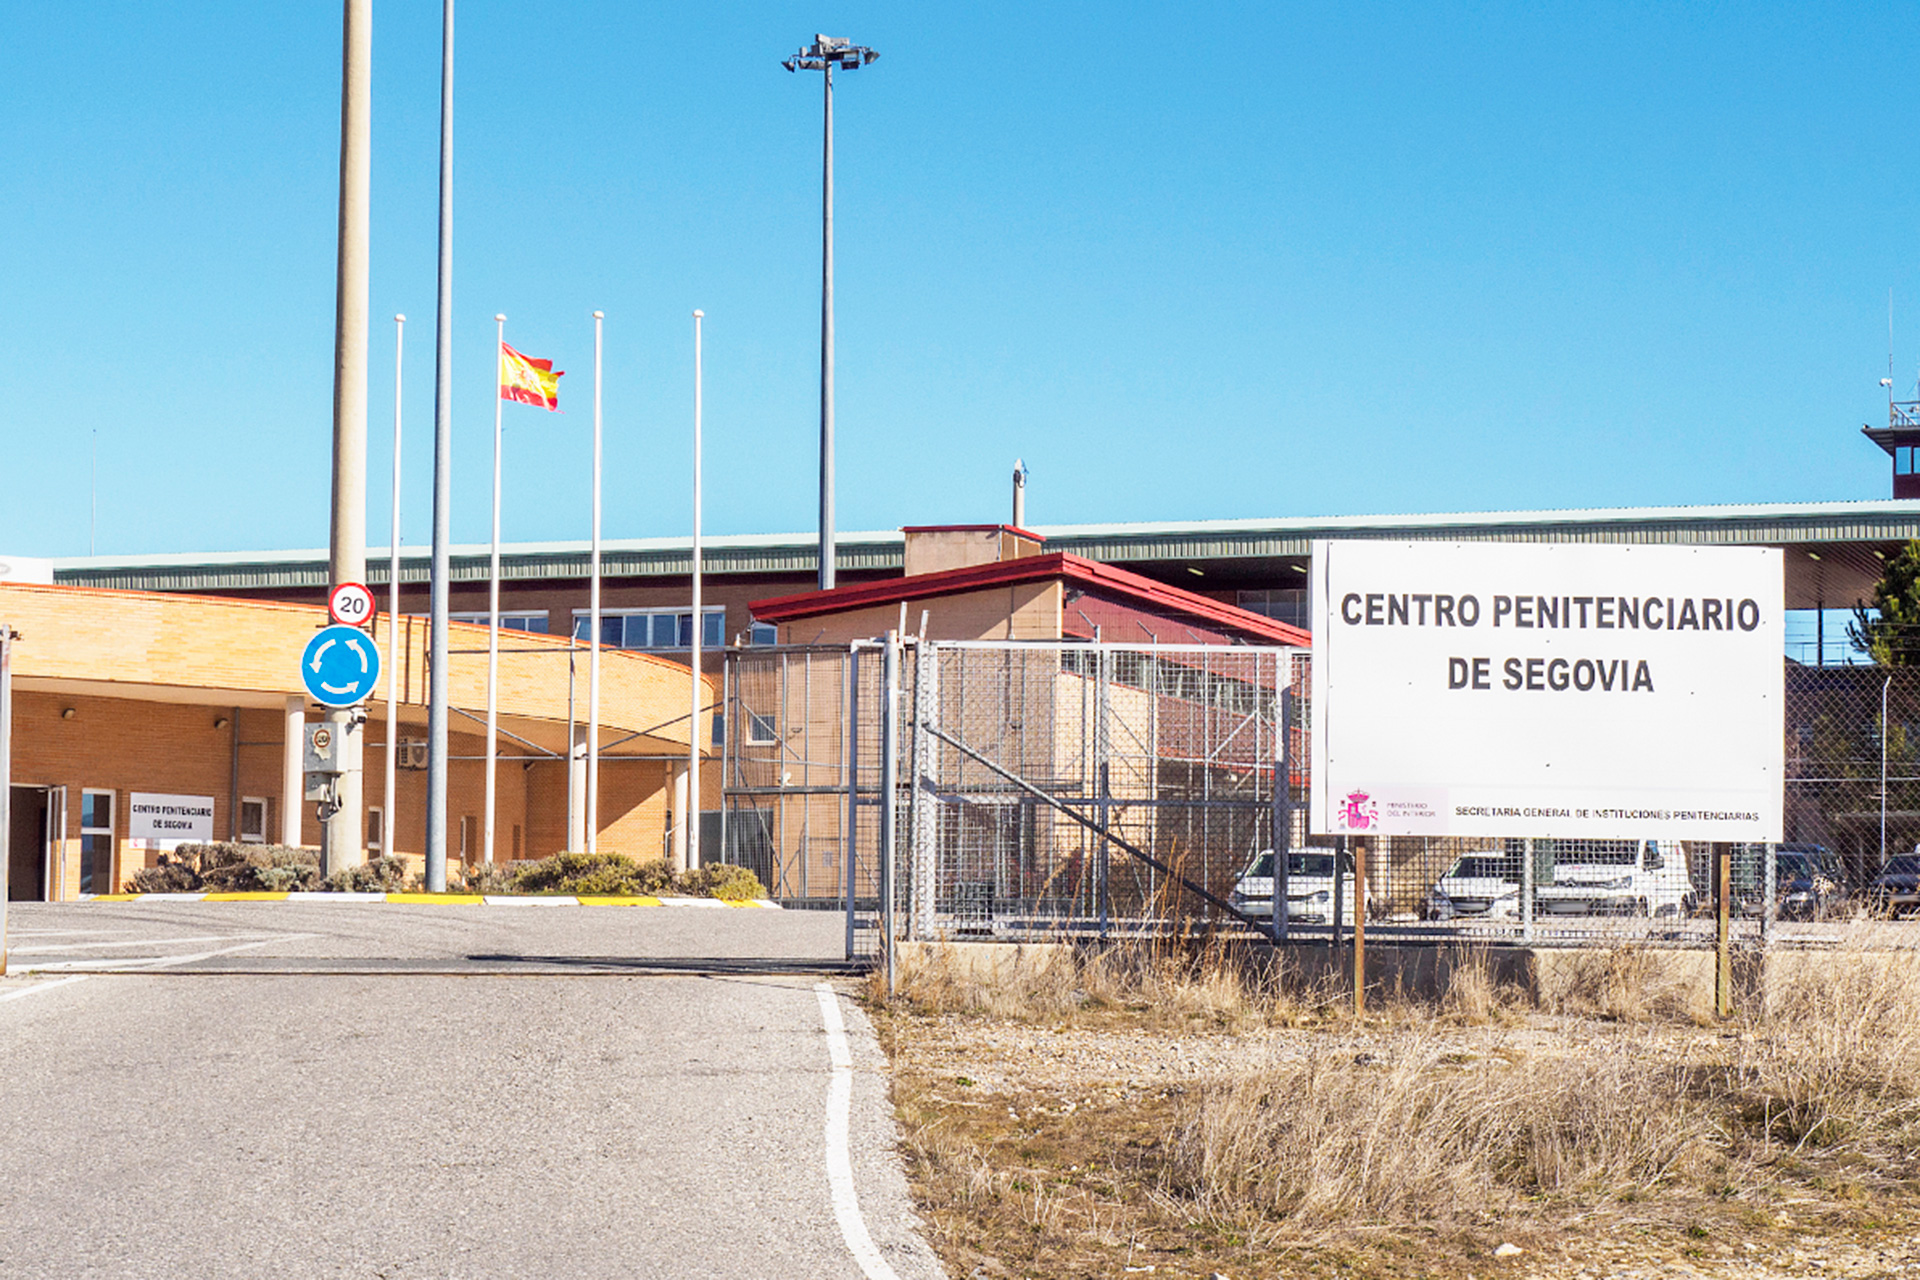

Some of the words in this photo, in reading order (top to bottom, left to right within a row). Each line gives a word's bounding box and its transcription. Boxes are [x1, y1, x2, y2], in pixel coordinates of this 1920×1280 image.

[340, 596, 364, 614] 20
[1341, 592, 1480, 627] CENTRO
[1492, 594, 1761, 632] PENITENCIARIO
[1448, 657, 1491, 690] DE
[1502, 658, 1655, 693] SEGOVIA
[133, 804, 161, 814] CENTRO
[162, 806, 212, 817] PENITENCIARIO
[1523, 807, 1570, 818] GENERAL
[1575, 808, 1589, 818] DE
[1592, 809, 1671, 820] INSTITUCIONES
[1673, 810, 1759, 821] PENITENCIARIAS
